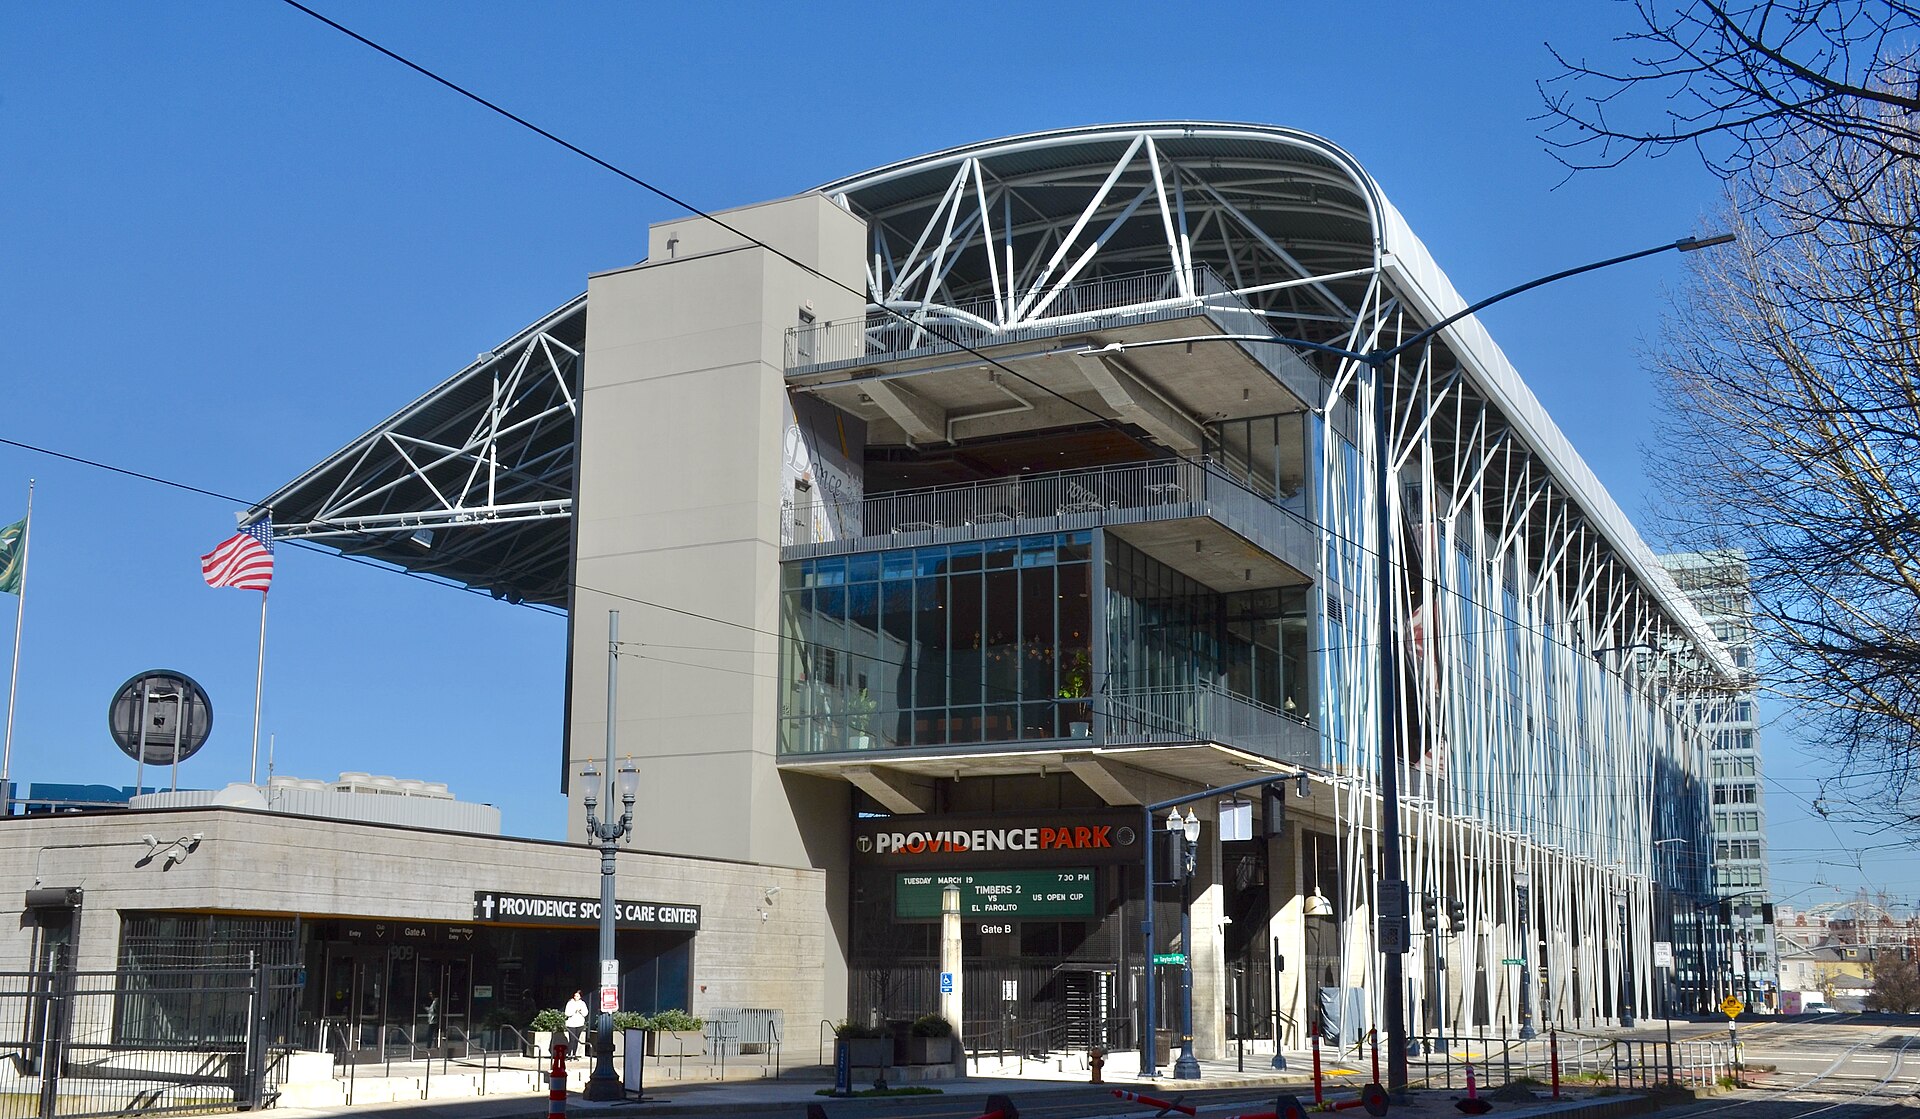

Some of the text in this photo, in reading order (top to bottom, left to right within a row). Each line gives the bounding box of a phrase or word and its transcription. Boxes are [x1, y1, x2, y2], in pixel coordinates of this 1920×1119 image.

[975, 885, 1021, 894] TIMBERS 2
[499, 898, 697, 924] PROVIDENCE SPOS CARE CENTER
[349, 929, 361, 937] Entry
[404, 927, 427, 937] Gate A
[981, 924, 1012, 934] Gate B
